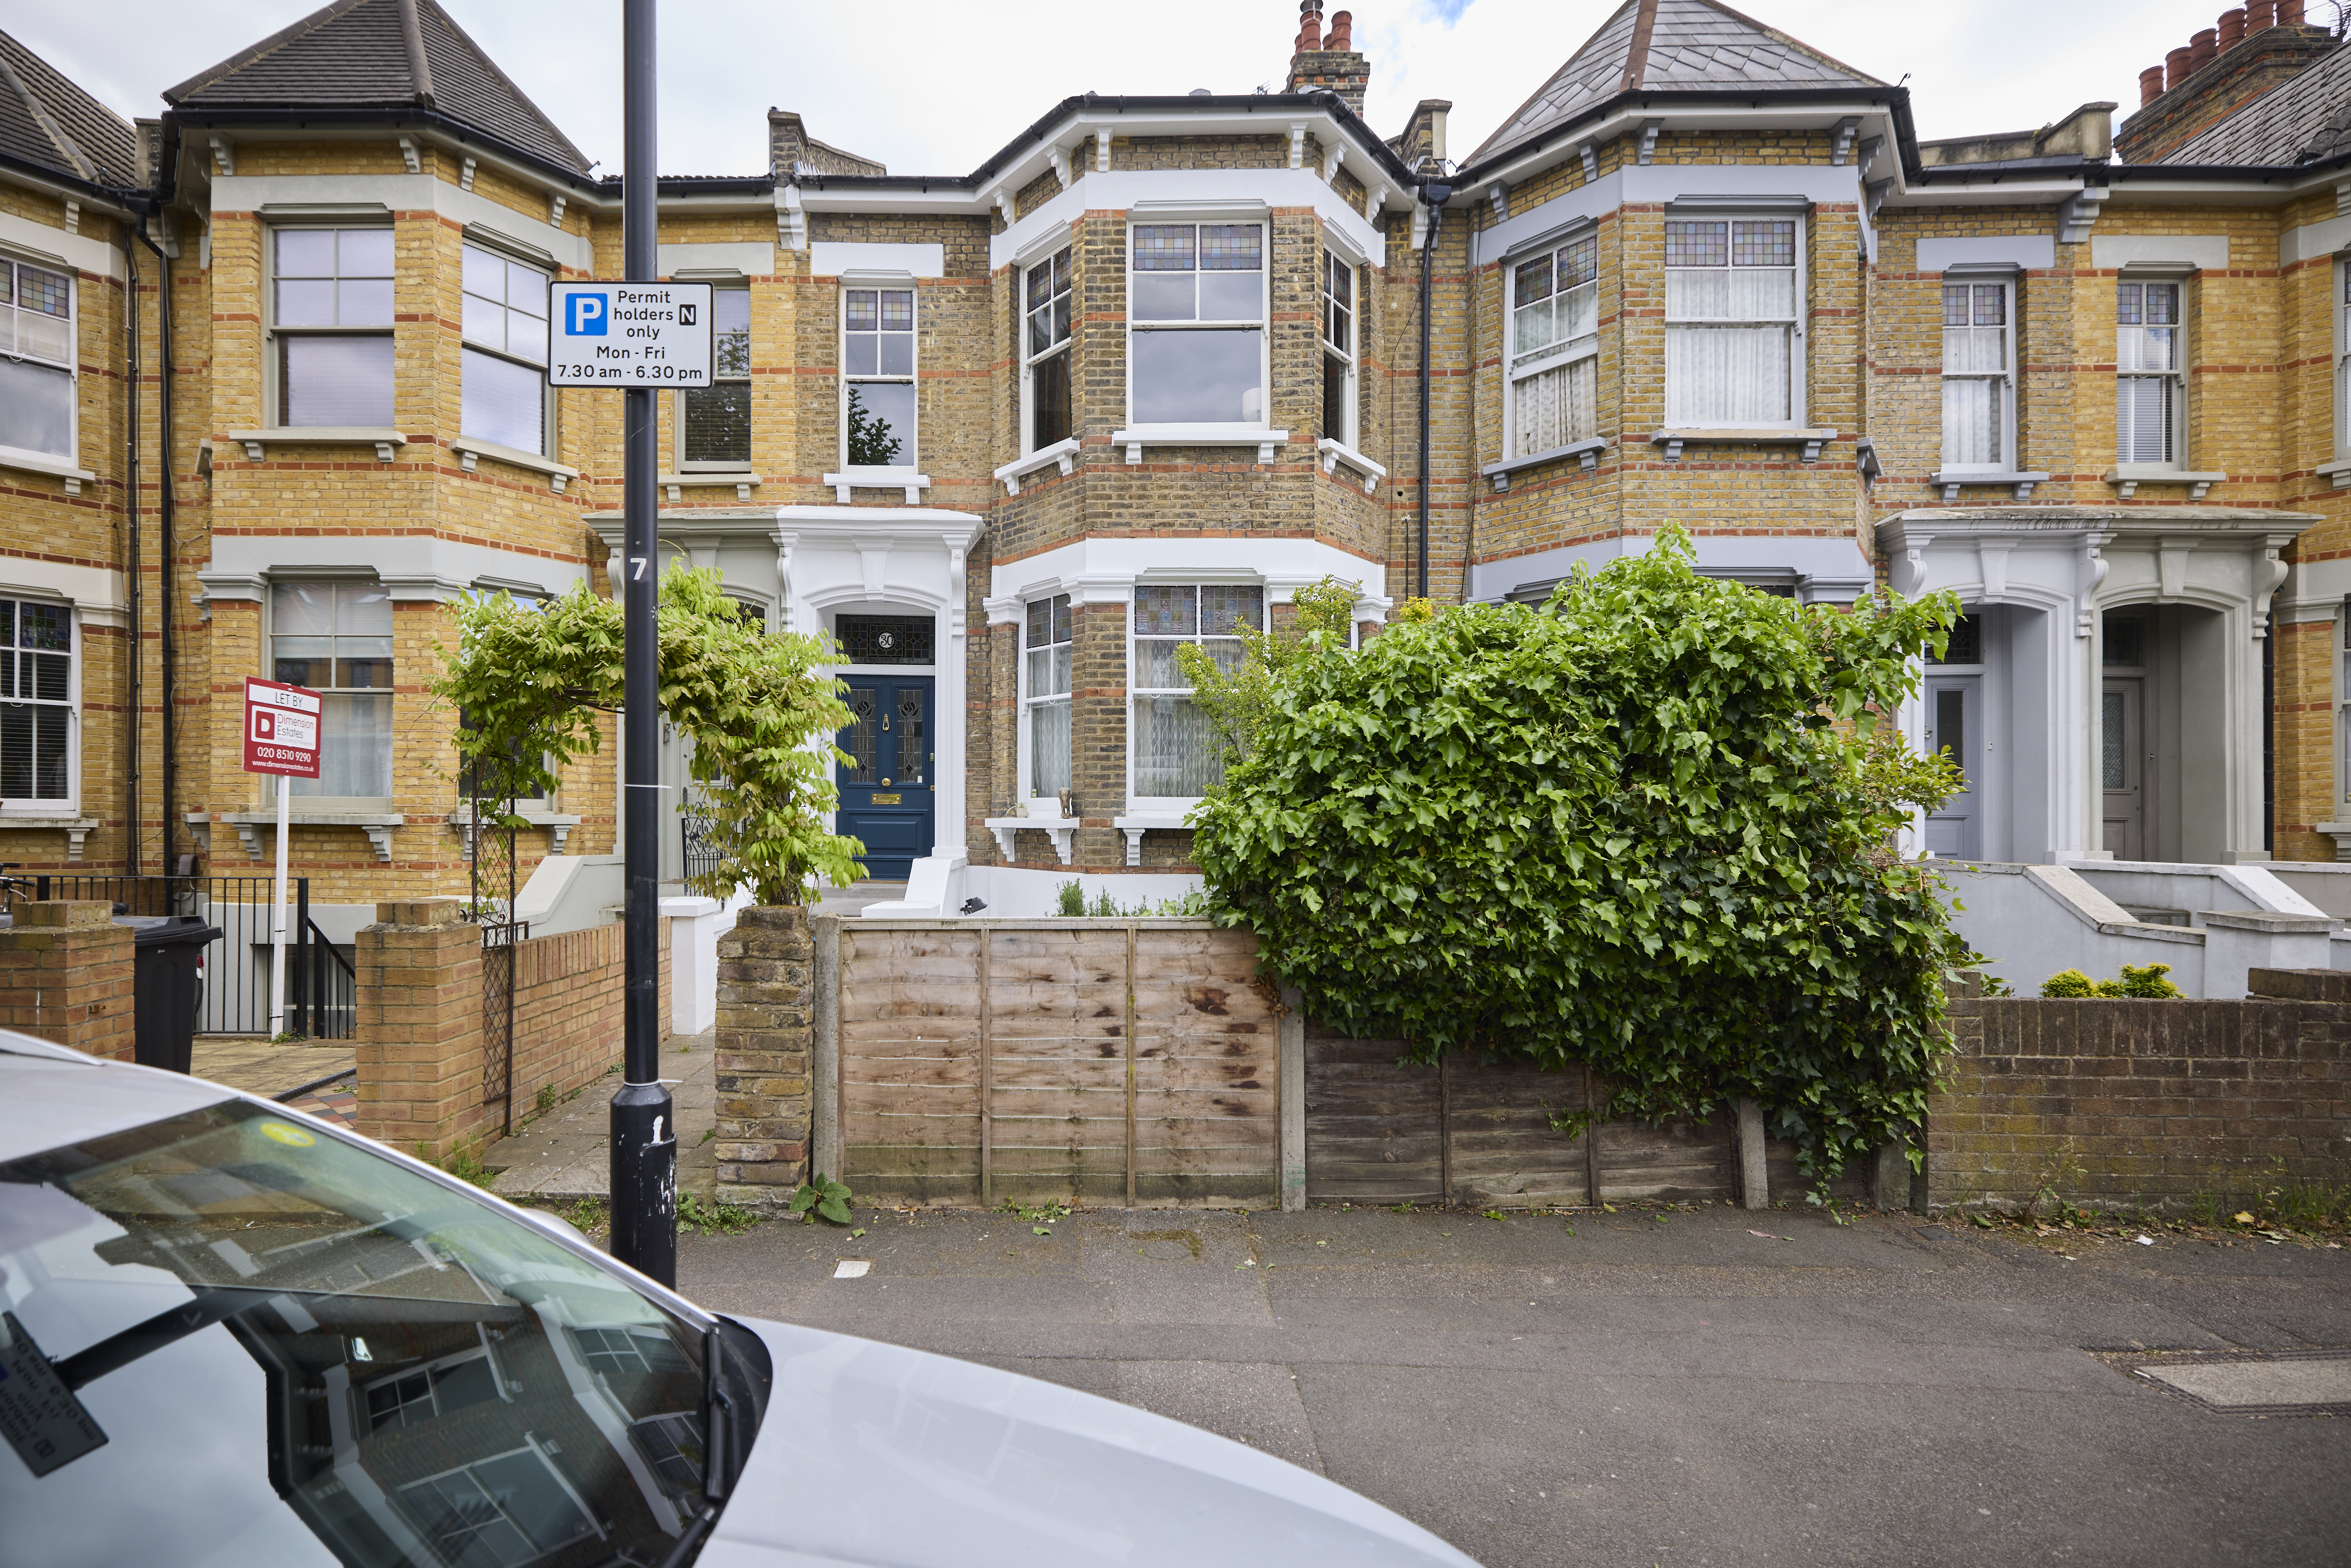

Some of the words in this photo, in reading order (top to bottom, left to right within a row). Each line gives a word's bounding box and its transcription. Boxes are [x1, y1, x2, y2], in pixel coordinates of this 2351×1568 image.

[618, 290, 671, 303] Permit
[576, 298, 602, 332] P
[614, 307, 673, 321] holders
[681, 307, 695, 323] N
[627, 325, 660, 340] only
[597, 346, 630, 359] Mon
[645, 346, 665, 359] Fri
[558, 364, 594, 378] 7.30
[599, 368, 621, 378] am
[636, 365, 674, 379] 6.30
[679, 369, 702, 381] pm
[630, 558, 647, 580] 7
[880, 635, 893, 646] 30
[275, 692, 290, 705] LET
[293, 696, 303, 707] BY
[261, 718, 270, 732] D
[277, 714, 314, 730] Dimension
[277, 725, 303, 739] Estates
[257, 747, 275, 758] 020
[276, 749, 294, 760] 8510
[295, 751, 311, 762] 9290
